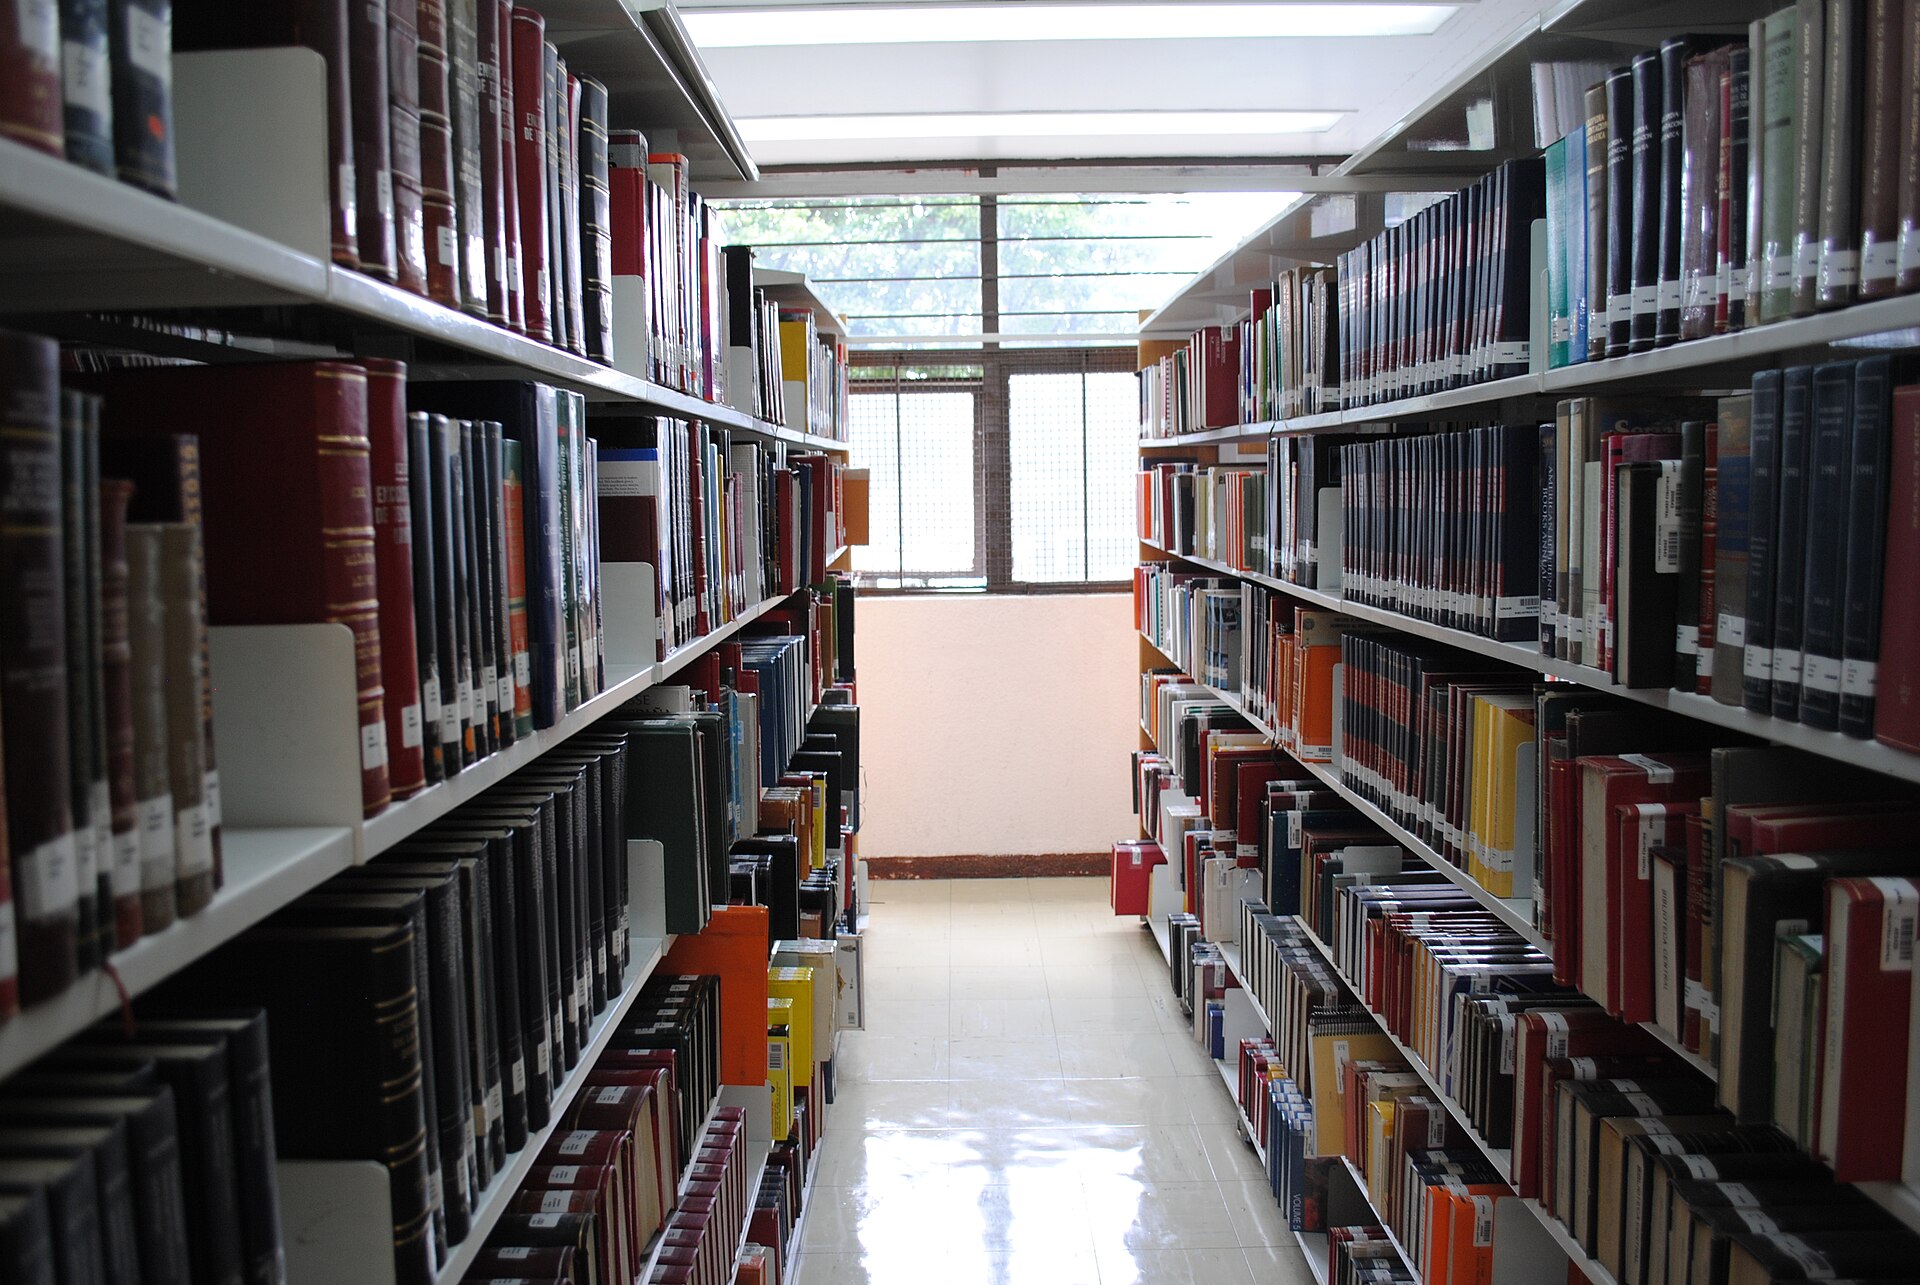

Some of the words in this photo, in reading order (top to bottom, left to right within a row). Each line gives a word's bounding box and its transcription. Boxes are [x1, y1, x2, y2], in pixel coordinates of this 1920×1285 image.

[1802, 23, 1810, 55] GUIDE
[1832, 41, 1838, 56] TO
[1802, 60, 1809, 75] TO
[1801, 78, 1809, 139] REFERENCE
[1799, 145, 1807, 195] MATERIAL
[1828, 129, 1836, 182] MATERIAL
[1820, 464, 1838, 476] 1991
[1855, 463, 1873, 476] 1991
[562, 489, 571, 552] Encyclopedia
[1541, 487, 1549, 529] BOOKS
[1547, 465, 1555, 531] AMERICAN
[1541, 532, 1549, 581] ANNUAL
[1661, 888, 1670, 945] BIBLIOTECA
[1293, 1194, 1302, 1223] VOLUME
